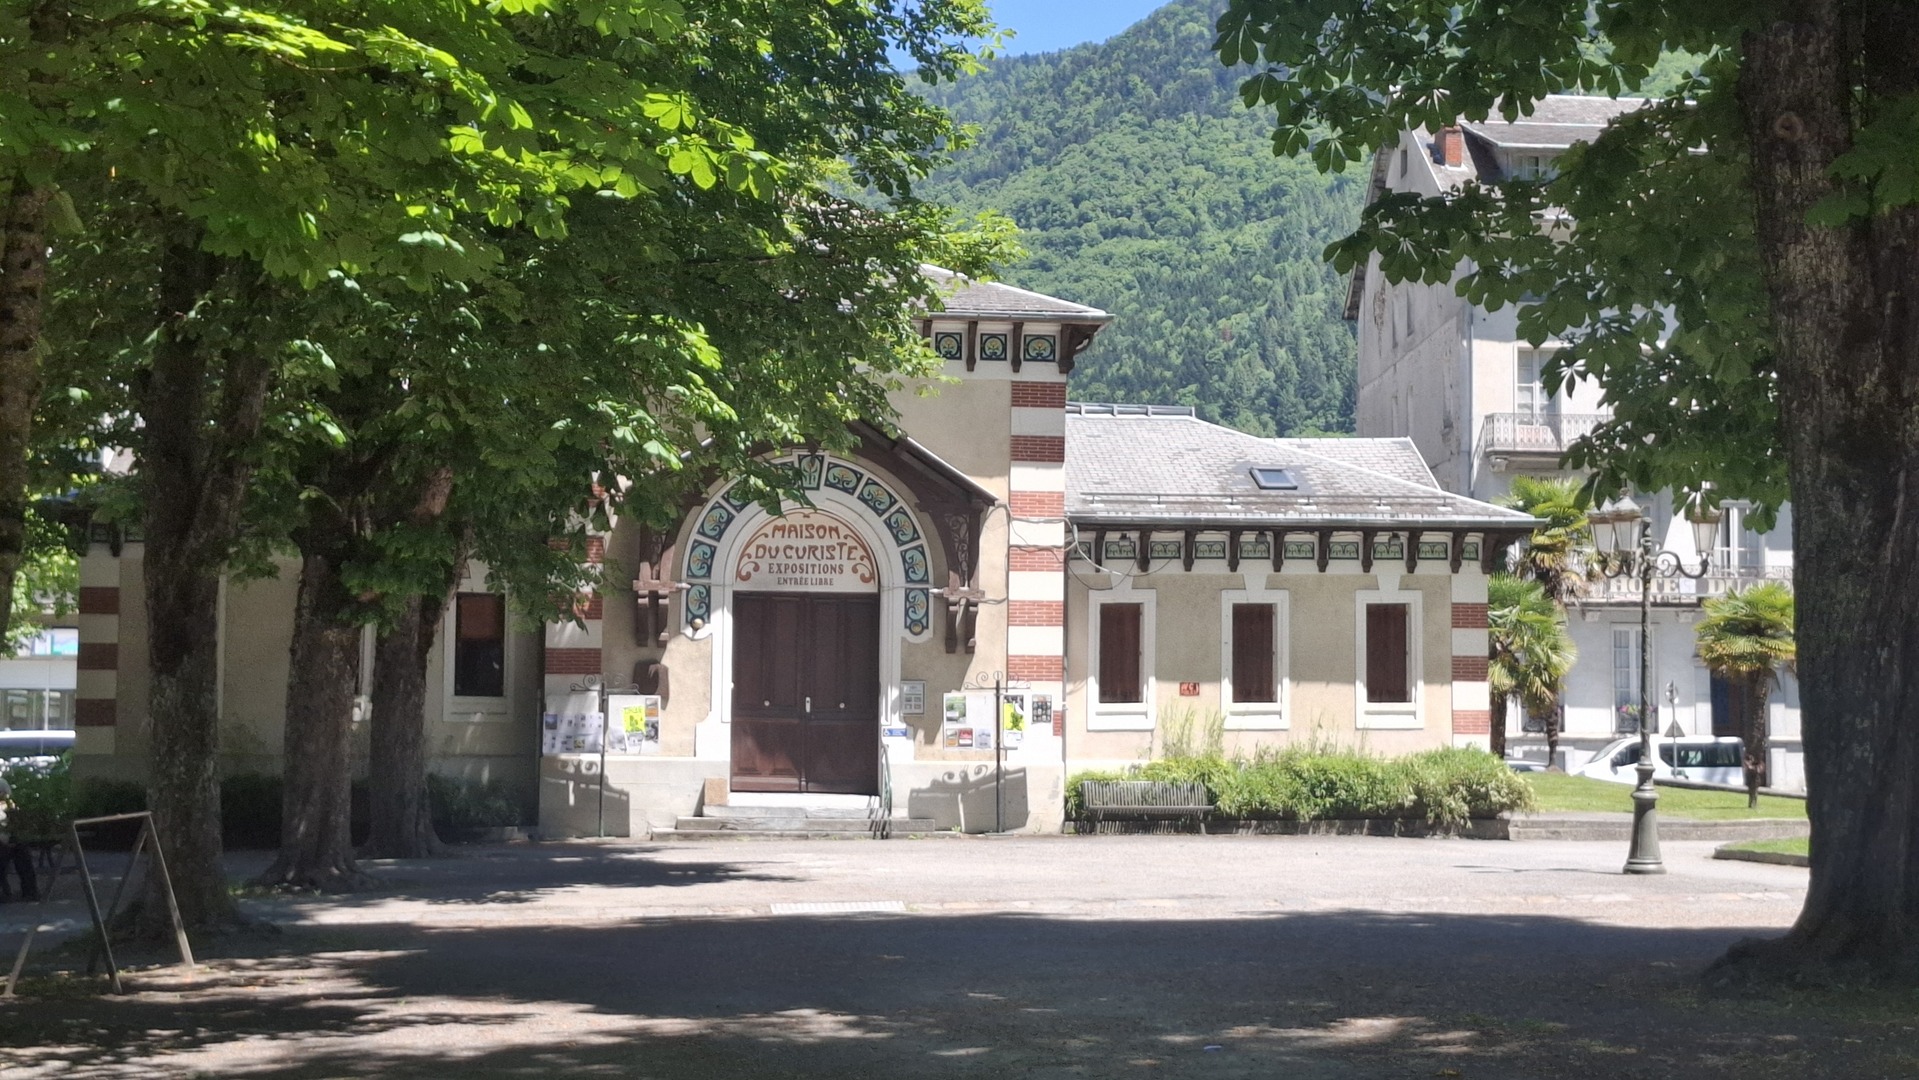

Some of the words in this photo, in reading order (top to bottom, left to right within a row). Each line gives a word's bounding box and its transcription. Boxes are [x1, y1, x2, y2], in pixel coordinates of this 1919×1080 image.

[771, 523, 841, 540] MAISON
[754, 543, 780, 560] DU
[782, 541, 858, 562] CURISTE
[768, 562, 845, 575] EXPOSITIONS
[810, 577, 834, 586] LIBRE
[1609, 577, 1696, 594] HOTE
